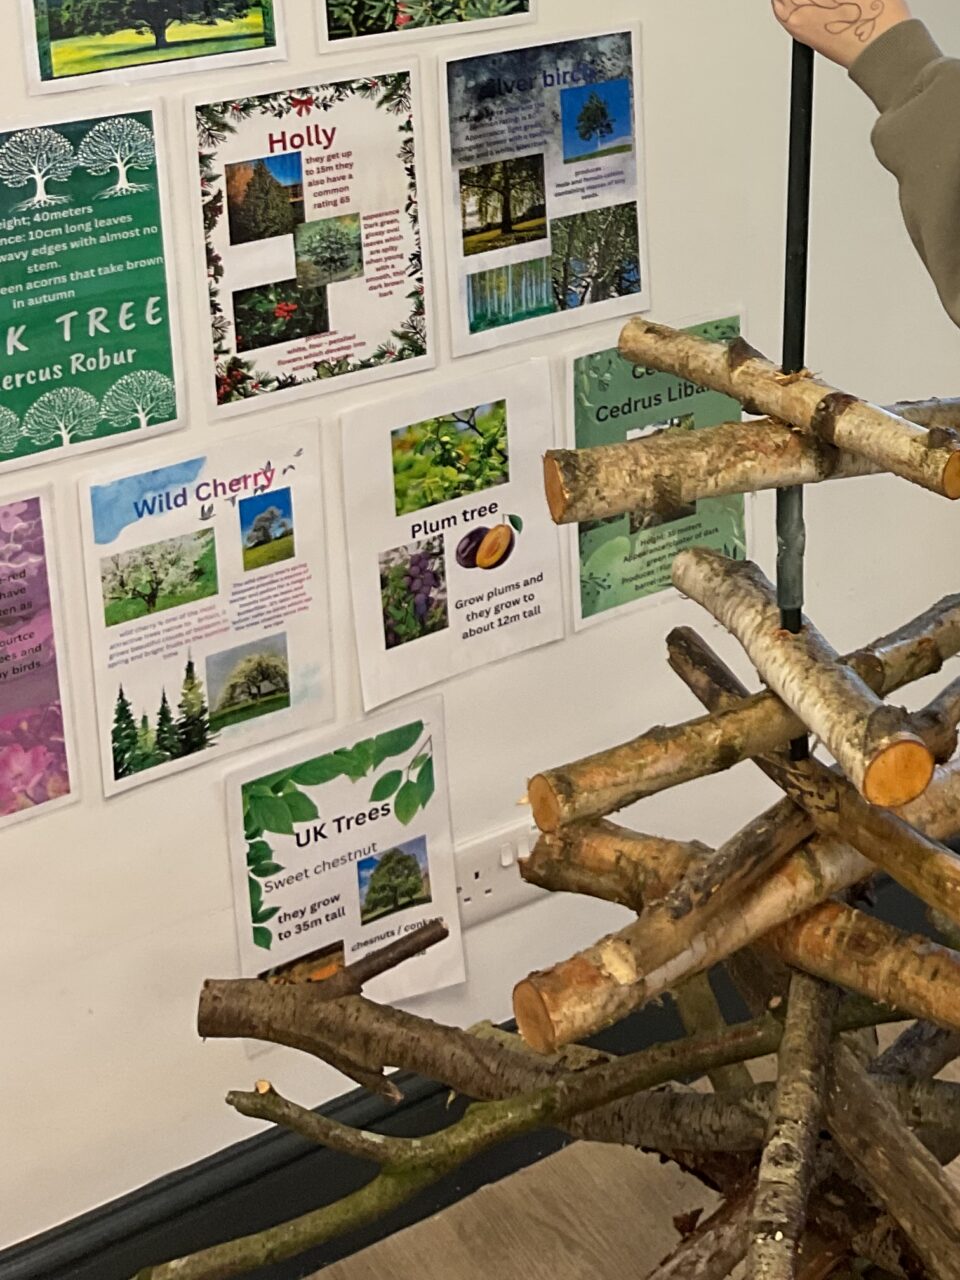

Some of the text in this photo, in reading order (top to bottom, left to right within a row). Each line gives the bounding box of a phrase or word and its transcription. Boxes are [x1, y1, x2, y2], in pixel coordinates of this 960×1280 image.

[268, 124, 337, 153] Holly
[305, 150, 352, 165] they get up
[316, 165, 334, 174] 15m
[335, 161, 354, 170] they
[307, 178, 325, 187] also
[326, 174, 346, 183] have
[312, 185, 350, 198] common
[33, 205, 94, 223] 40meters
[313, 198, 338, 209] rating
[29, 227, 62, 241] 10cm
[65, 221, 92, 234] long
[94, 214, 133, 228] leaves
[31, 241, 68, 255] edges
[70, 235, 97, 249] with
[99, 228, 141, 243] almost
[143, 225, 158, 234] no
[25, 273, 67, 290] acorns
[70, 269, 95, 282] that
[97, 263, 124, 276] take
[126, 256, 164, 271] brown
[27, 261, 62, 274] stem.
[12, 289, 76, 310] in autumn
[55, 296, 163, 342] TREE
[70, 348, 137, 376] Robur
[596, 381, 709, 422] Cedrus Liba
[134, 468, 276, 520] Wild Cherry
[411, 502, 499, 539] Plum tree
[0, 586, 26, 600] have
[455, 572, 544, 610] Grow plums and
[20, 601, 33, 611] as
[466, 592, 535, 622] they grow to
[462, 604, 541, 640] about 12m tall
[20, 643, 42, 657] and
[12, 660, 41, 675] birds
[295, 802, 392, 848] UK Trees
[264, 841, 378, 894] Sweet chestnut
[277, 893, 341, 925] they grow
[277, 906, 346, 942] to 35m tall
[351, 929, 395, 952] chesnuts
